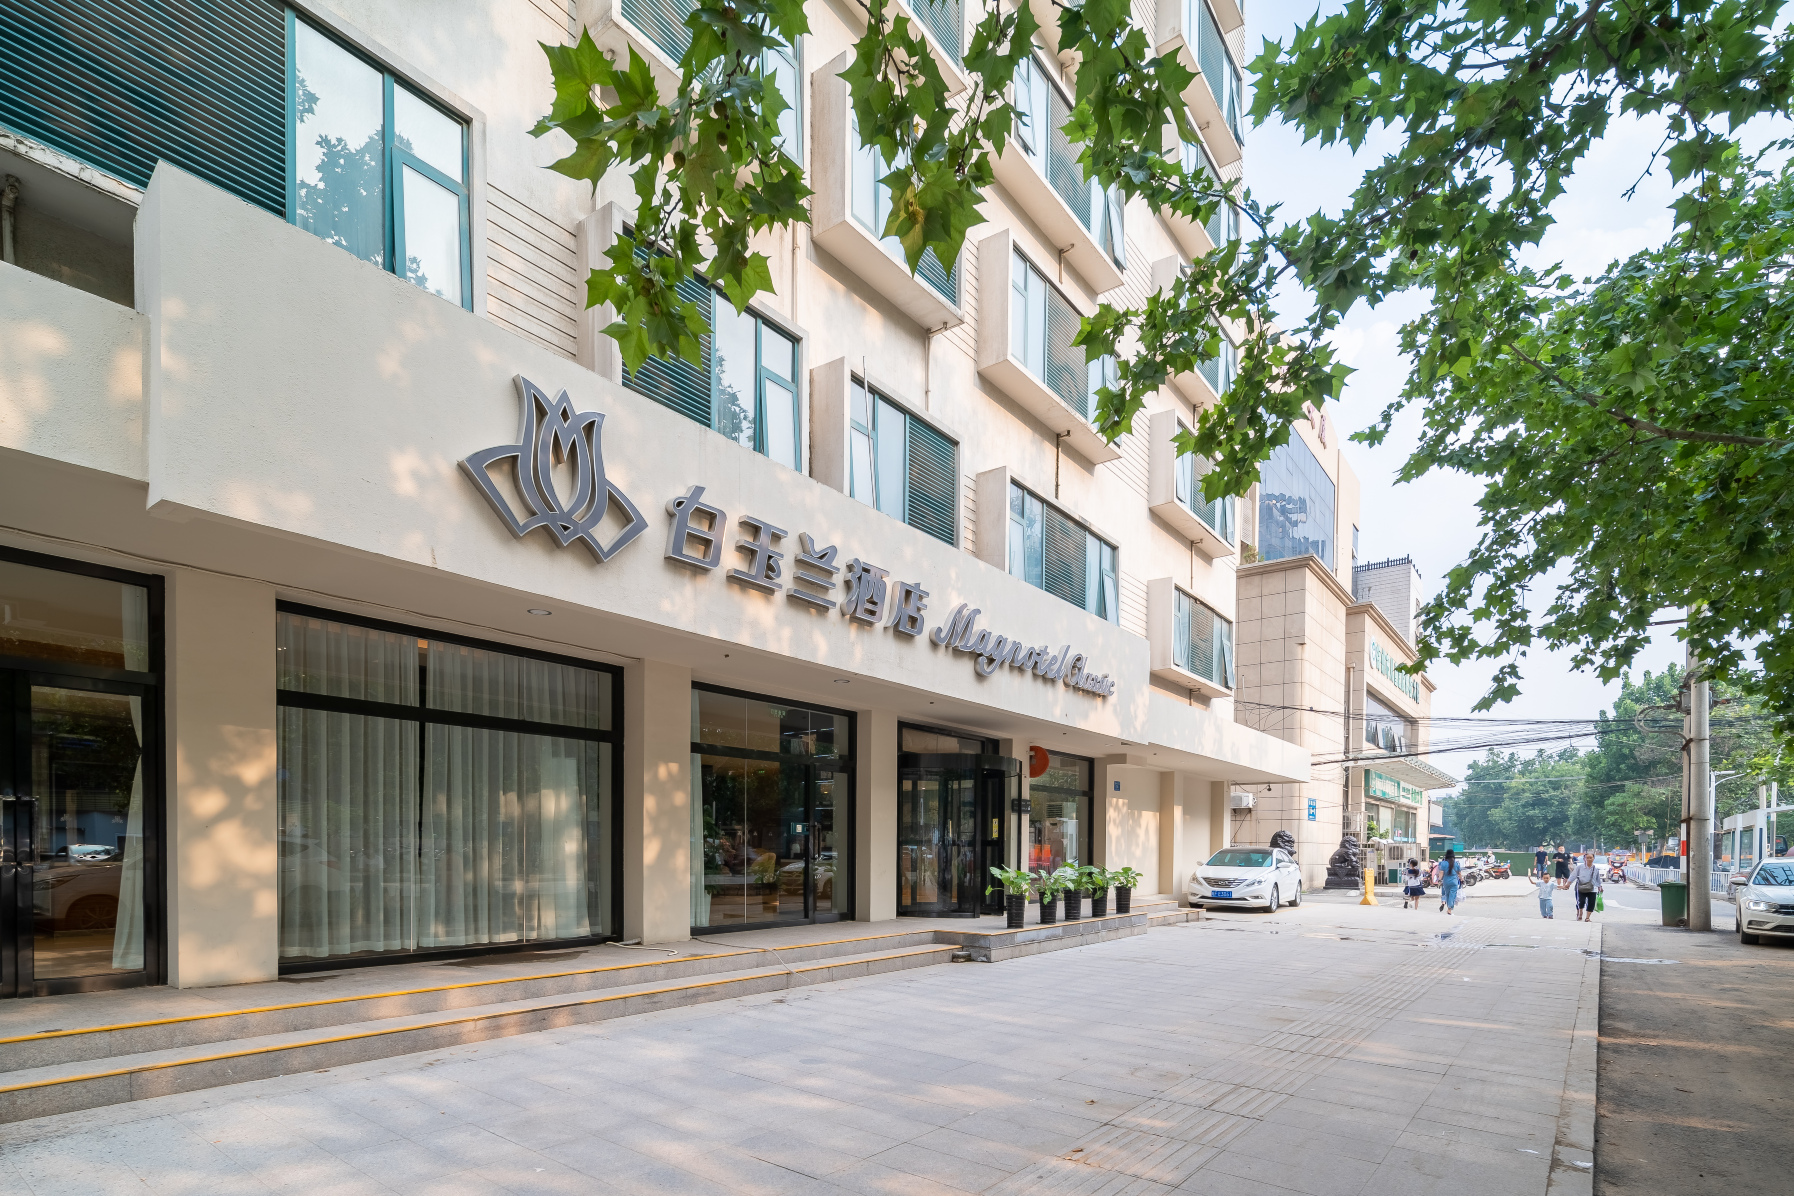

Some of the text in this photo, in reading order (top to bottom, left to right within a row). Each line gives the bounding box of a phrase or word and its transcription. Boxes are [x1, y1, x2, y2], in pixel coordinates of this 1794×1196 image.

[665, 485, 930, 638] 白玉兰酒店
[930, 602, 1116, 697] Magnotel Classic
